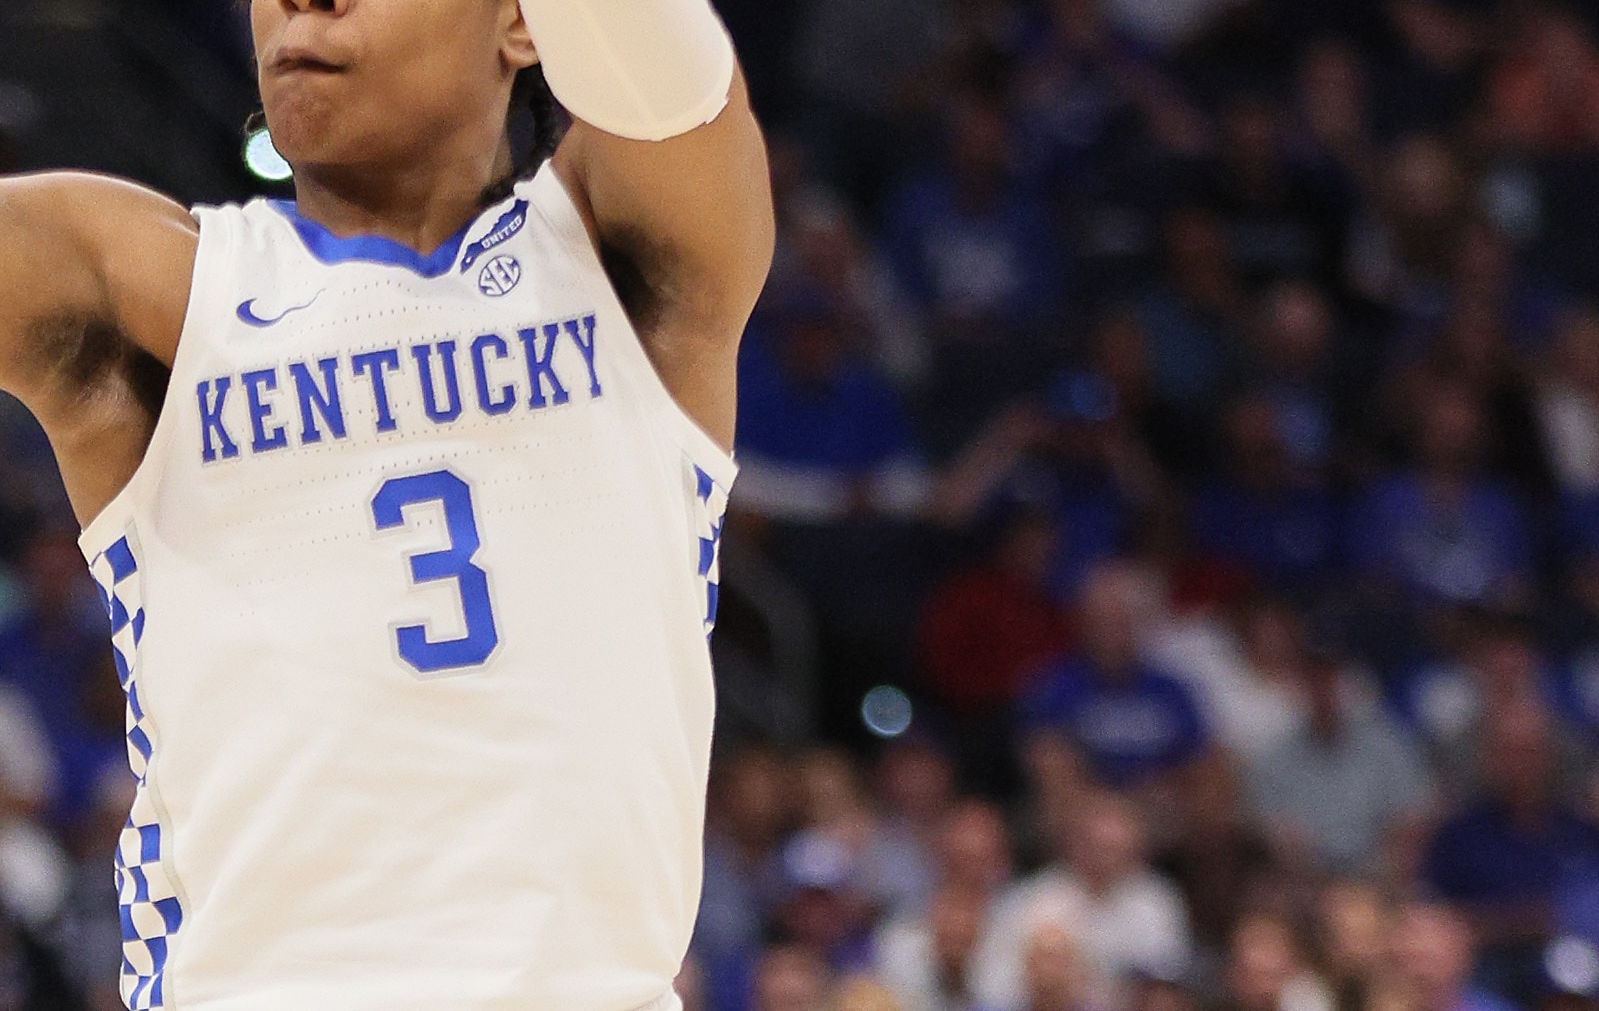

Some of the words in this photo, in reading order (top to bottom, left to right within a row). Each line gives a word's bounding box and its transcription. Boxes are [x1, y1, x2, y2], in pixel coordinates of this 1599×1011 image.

[479, 255, 521, 297] SEC
[481, 214, 522, 249] UNITED
[196, 312, 604, 465] KENTUCKY
[368, 465, 504, 676] 3
